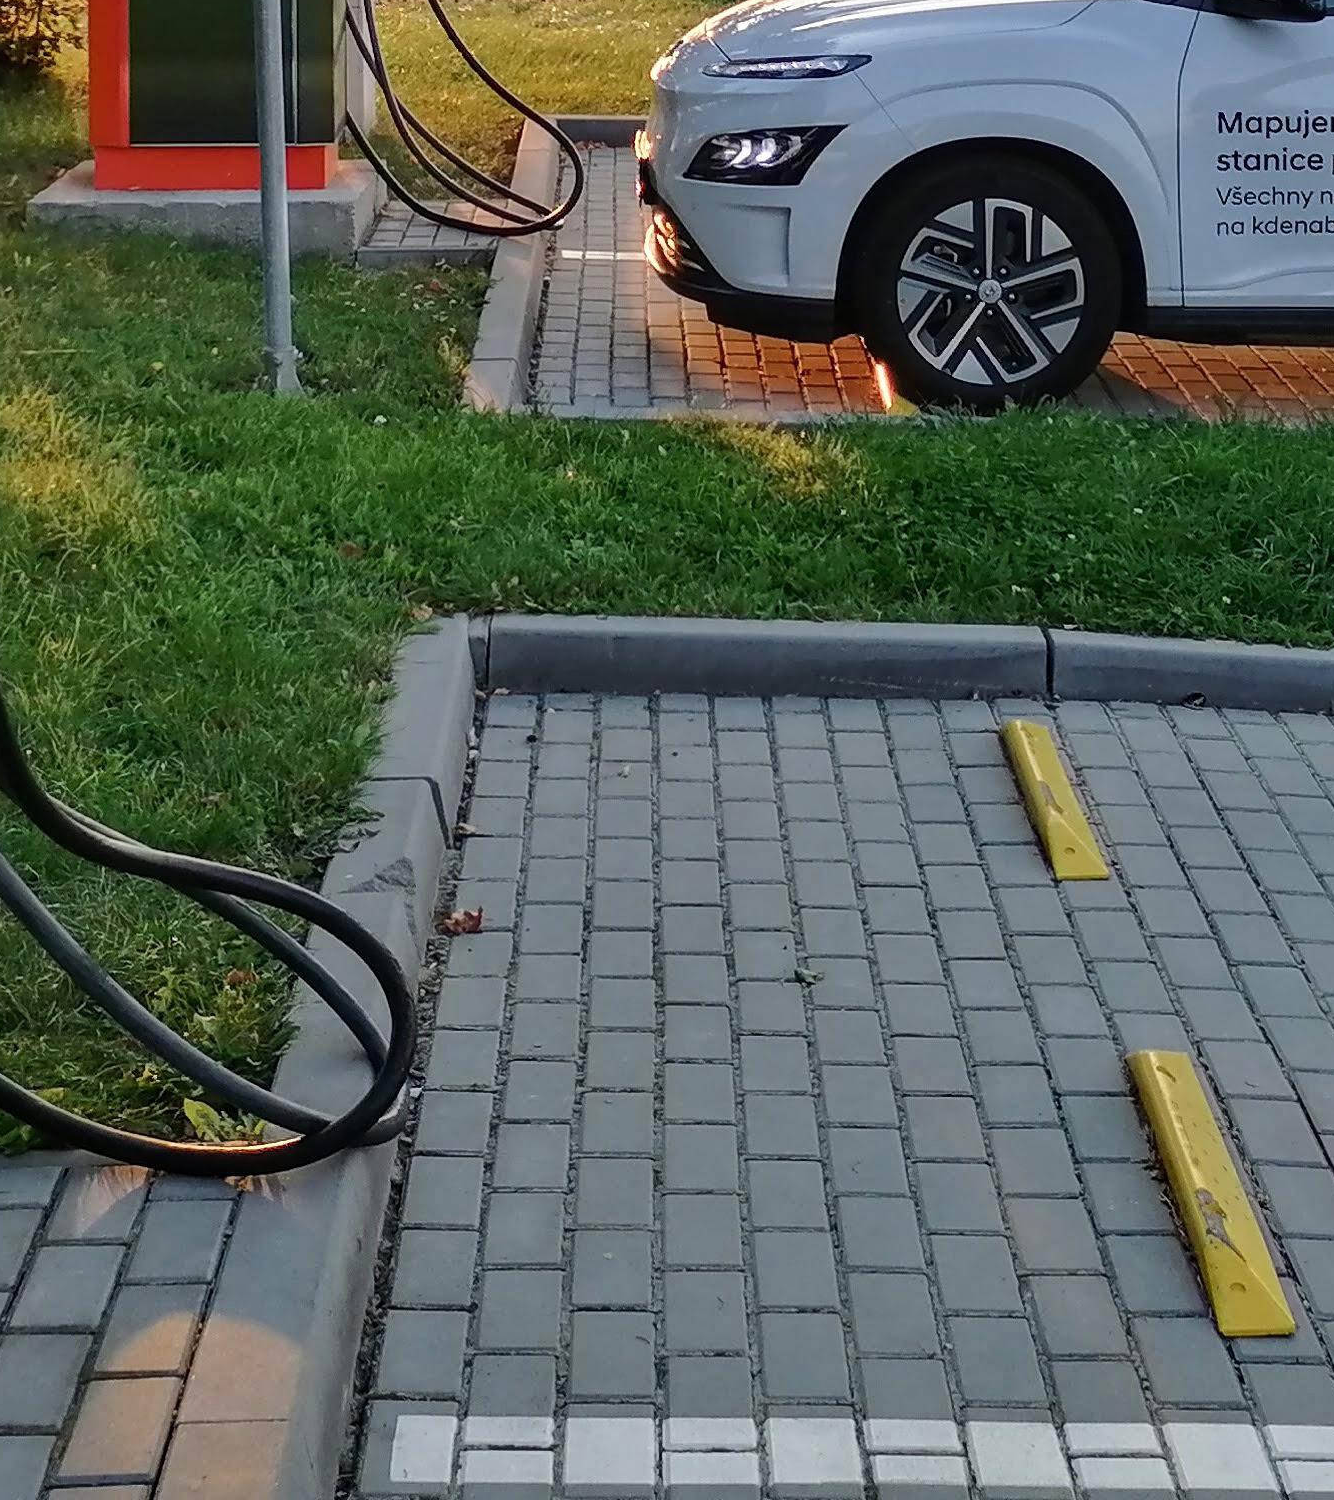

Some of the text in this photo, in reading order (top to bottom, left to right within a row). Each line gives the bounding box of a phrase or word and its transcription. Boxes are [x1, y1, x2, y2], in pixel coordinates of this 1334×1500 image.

[1216, 147, 1324, 172] stanice
[1216, 185, 1314, 209] Všechny
[1216, 219, 1245, 236] na
